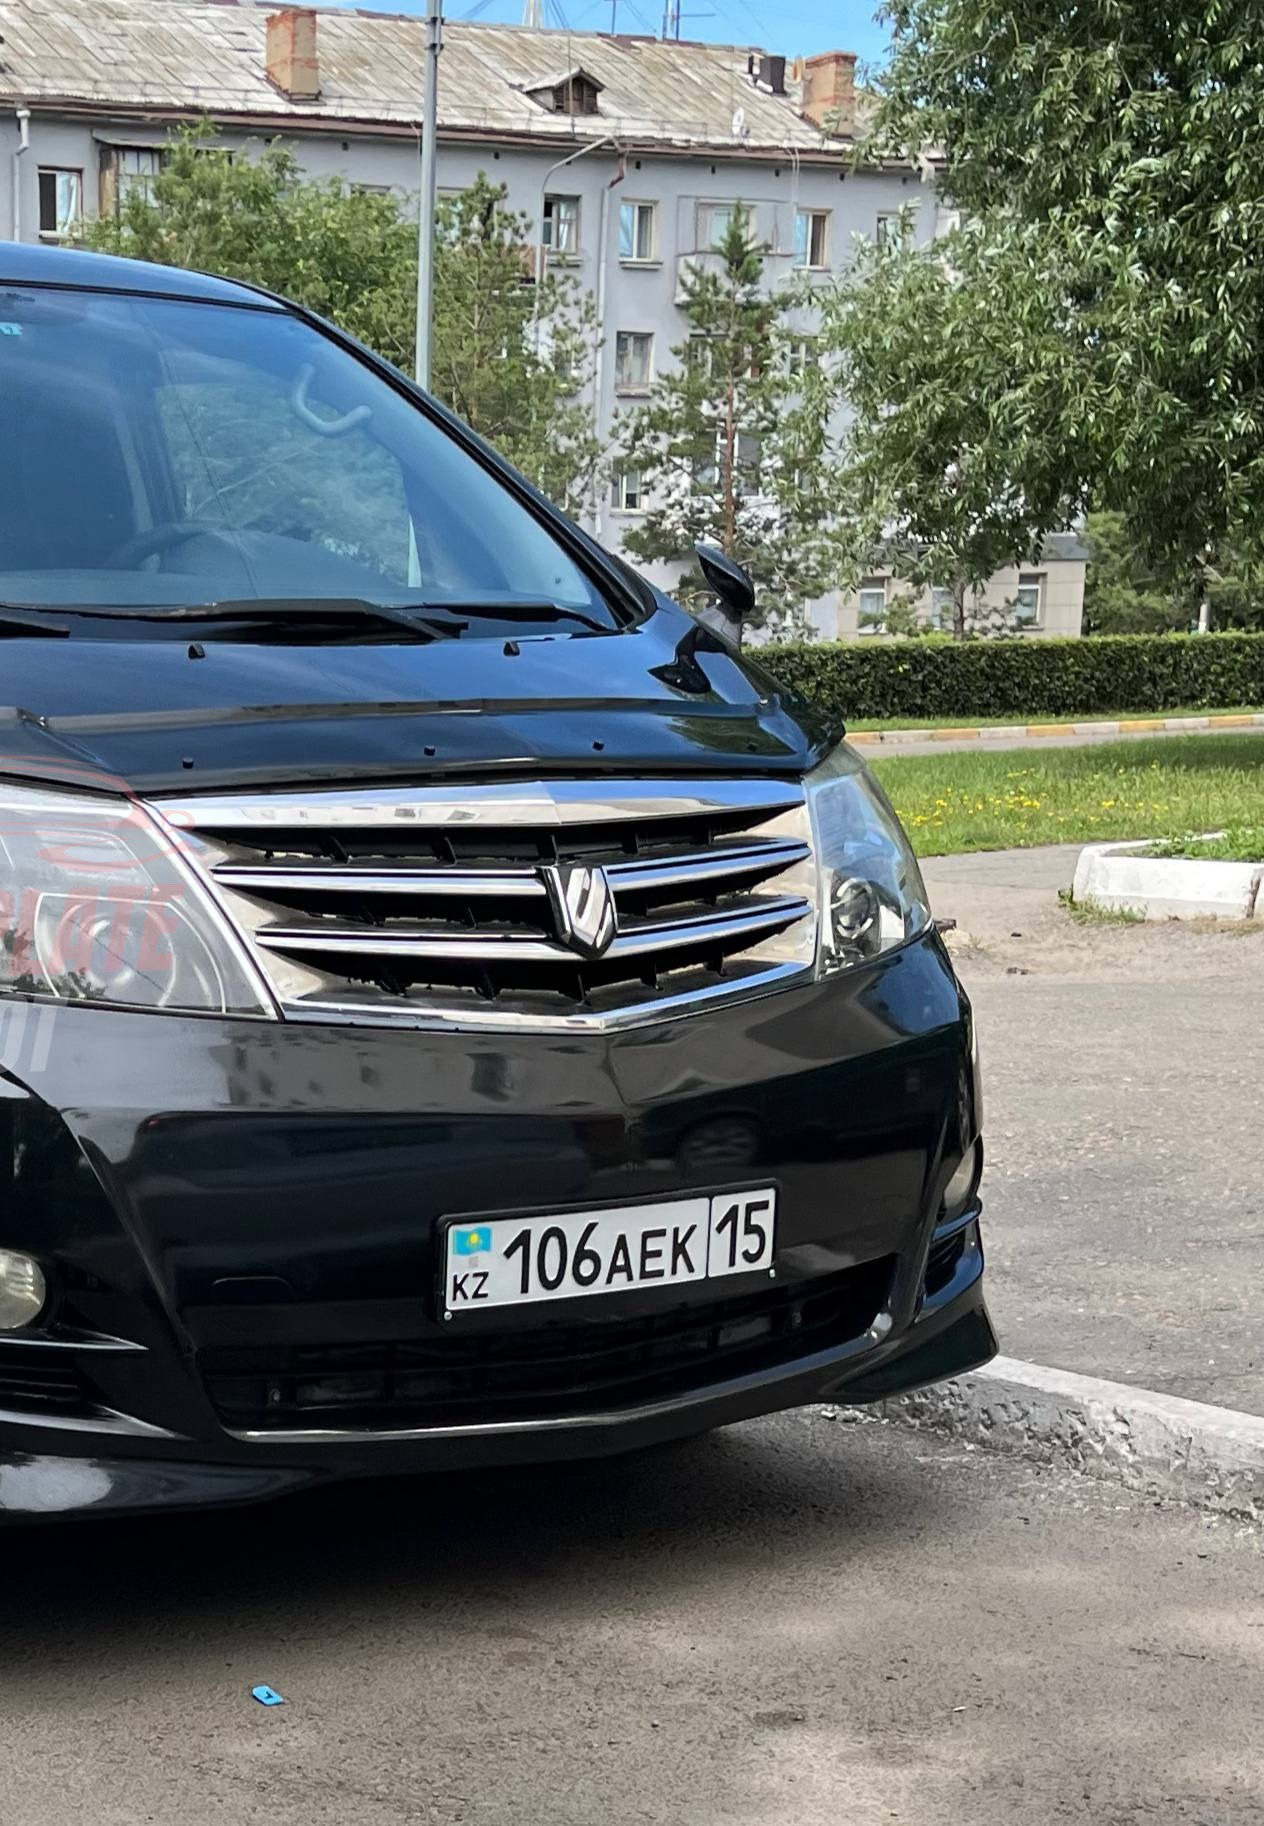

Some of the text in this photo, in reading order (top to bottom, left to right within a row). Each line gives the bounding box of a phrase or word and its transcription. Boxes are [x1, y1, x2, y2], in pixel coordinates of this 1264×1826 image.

[503, 1200, 770, 1294] 106AEK 15
[452, 1271, 489, 1301] KZ
